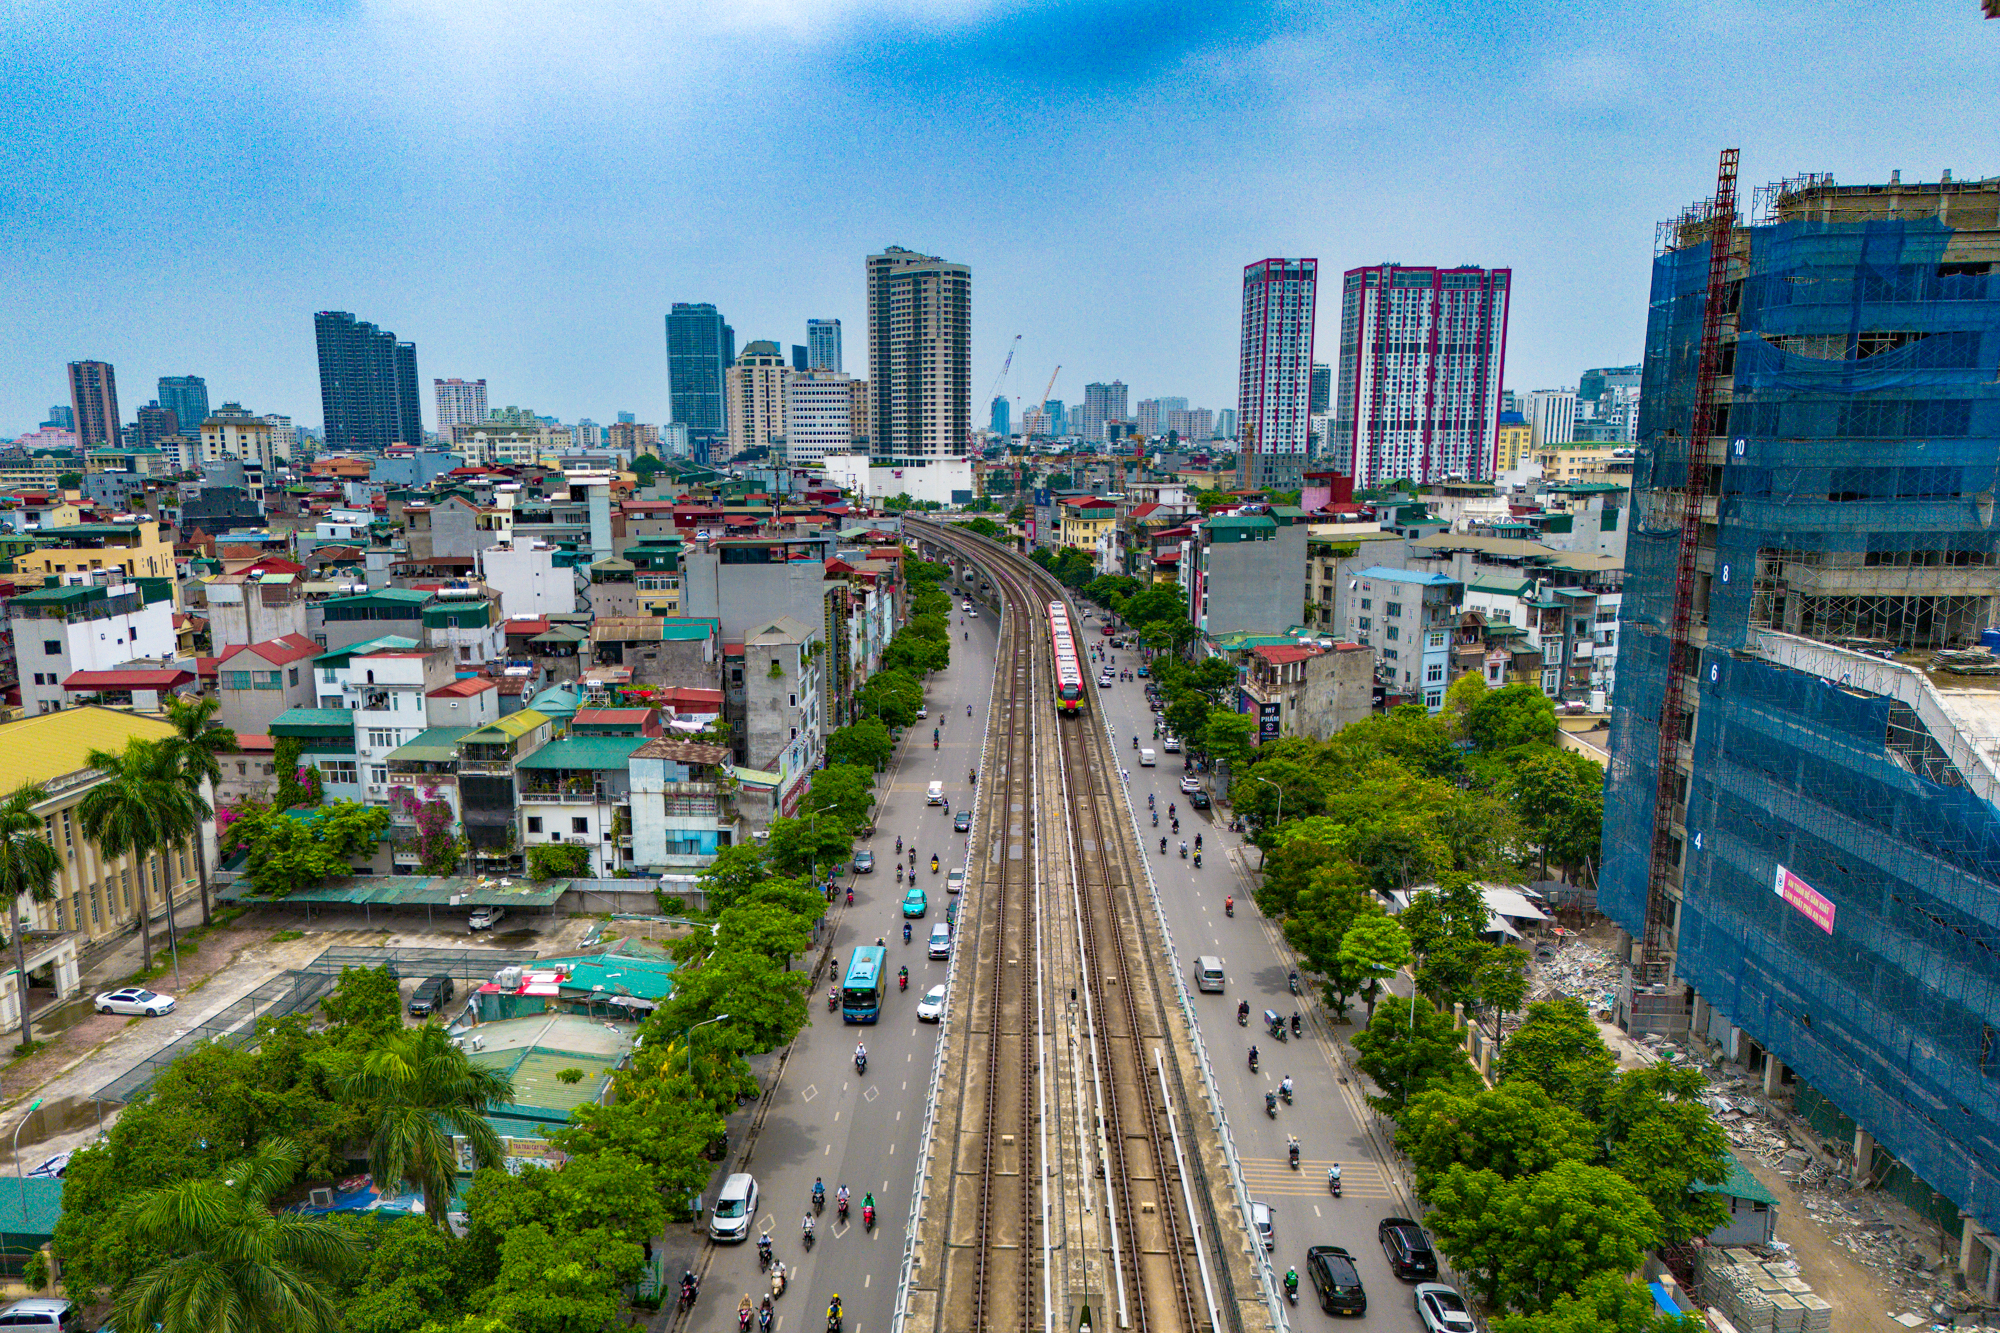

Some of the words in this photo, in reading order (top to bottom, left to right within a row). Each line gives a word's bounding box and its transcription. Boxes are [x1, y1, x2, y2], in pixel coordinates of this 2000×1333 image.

[1734, 439, 1745, 456] 10
[1722, 564, 1729, 582] 8
[1711, 664, 1718, 681] 6
[1694, 832, 1702, 850] 4
[1788, 879, 1793, 889] AN
[1794, 883, 1804, 896] TOÀN
[1804, 890, 1811, 901] ĐỂ
[1810, 895, 1818, 907] SẢN
[1819, 902, 1829, 915] XUẤT
[1793, 896, 1803, 908] XUẤT
[1803, 903, 1812, 916] PHẢI
[1812, 910, 1819, 922] AN
[1819, 915, 1829, 929] TOÀN
